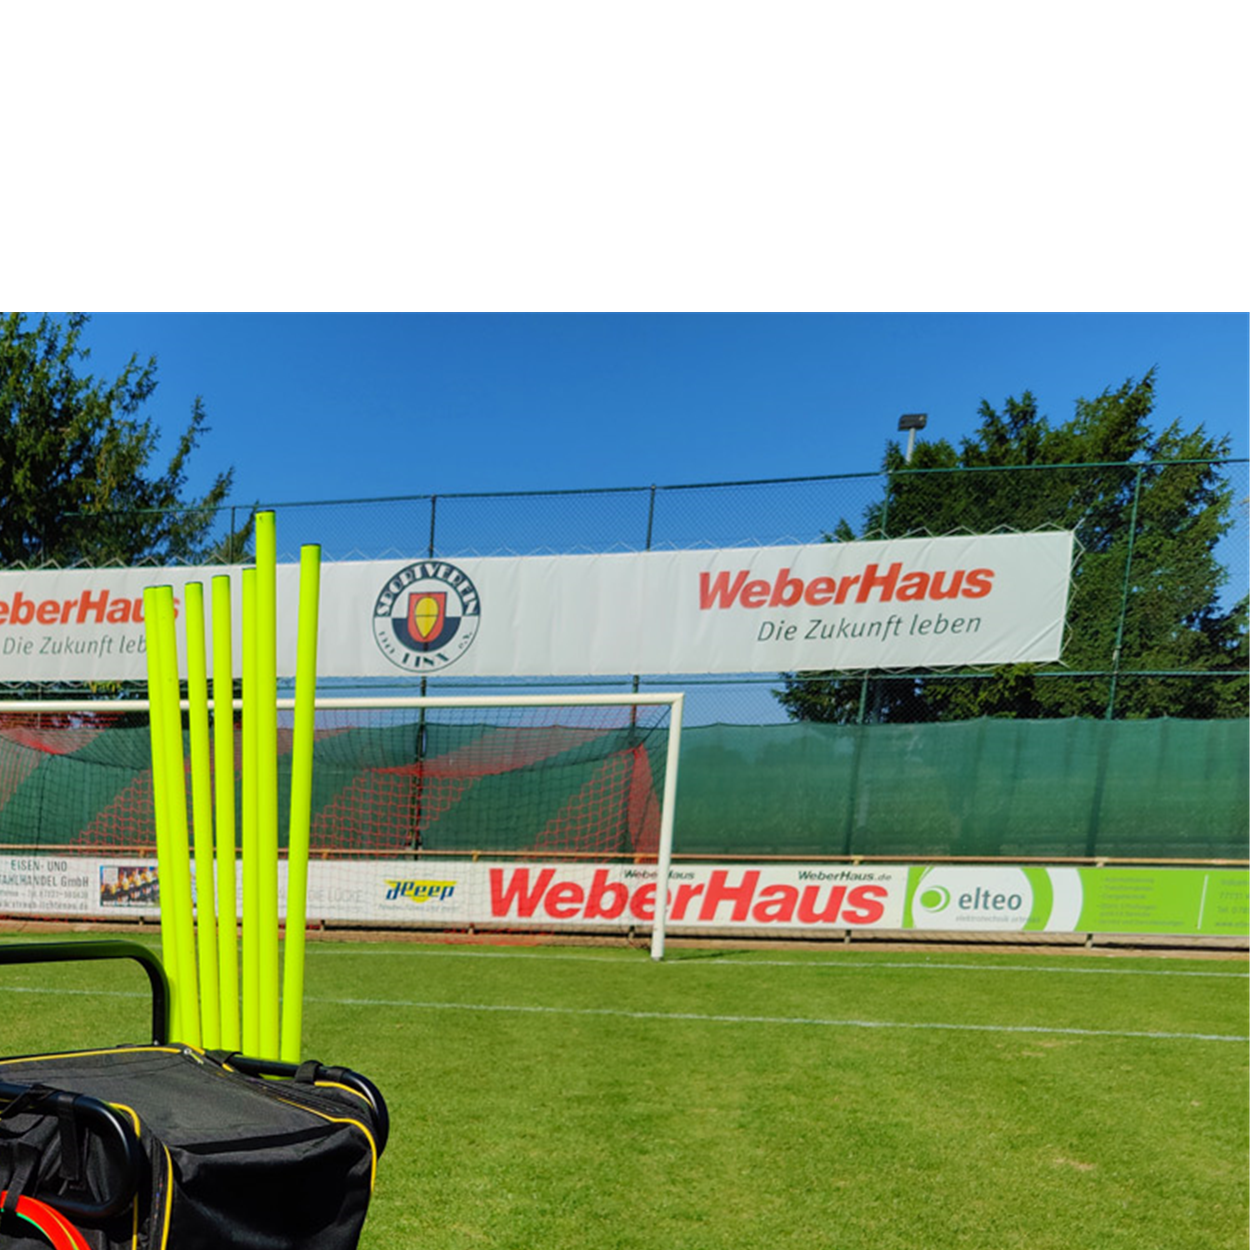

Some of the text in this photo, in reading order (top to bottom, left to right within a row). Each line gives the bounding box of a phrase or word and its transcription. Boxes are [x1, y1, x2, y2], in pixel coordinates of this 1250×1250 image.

[376, 563, 480, 616] SPORTVEREIN
[699, 562, 995, 610] WeberHaus
[757, 613, 981, 642] Die Zukunft leben
[3, 634, 148, 659] Die Zukunft leb
[402, 653, 449, 668] LINX
[61, 875, 89, 888] GmbH
[624, 869, 695, 880] Webeaus
[798, 870, 892, 881] WeberHaus.de
[489, 868, 888, 925] WeberHaus
[958, 887, 1022, 911] elteo
